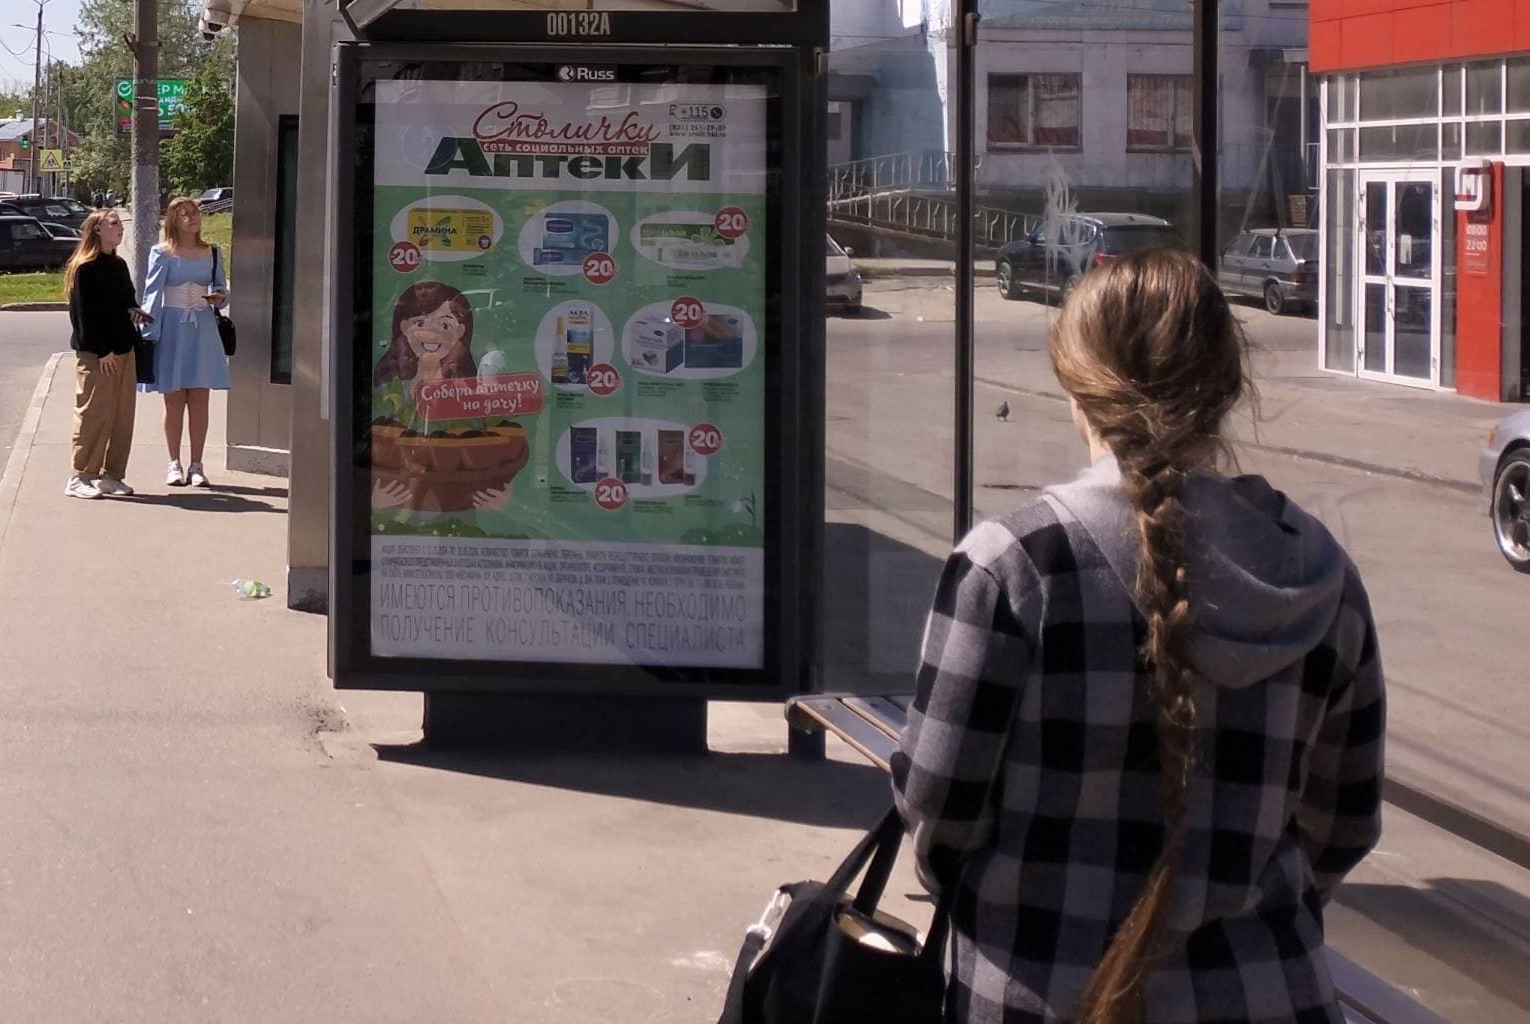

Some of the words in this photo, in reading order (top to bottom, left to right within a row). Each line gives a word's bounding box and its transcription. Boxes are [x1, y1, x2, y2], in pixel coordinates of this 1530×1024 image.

[577, 67, 615, 80] Russ
[472, 100, 662, 142] Столички
[483, 143, 512, 153] сеть
[516, 144, 603, 154] социальных
[607, 144, 649, 155] аптек
[463, 401, 480, 411] на
[483, 393, 523, 415] дачу!
[380, 583, 455, 611] ИМЕЮТСЯ
[635, 591, 747, 623] НЕОБХОДИМО
[380, 614, 475, 644] ПОЛУЧЕНИЕ
[485, 617, 615, 650] КОНСУЛЬТАЦИИ
[624, 621, 747, 653] СПЕЦИАЛИСТА
